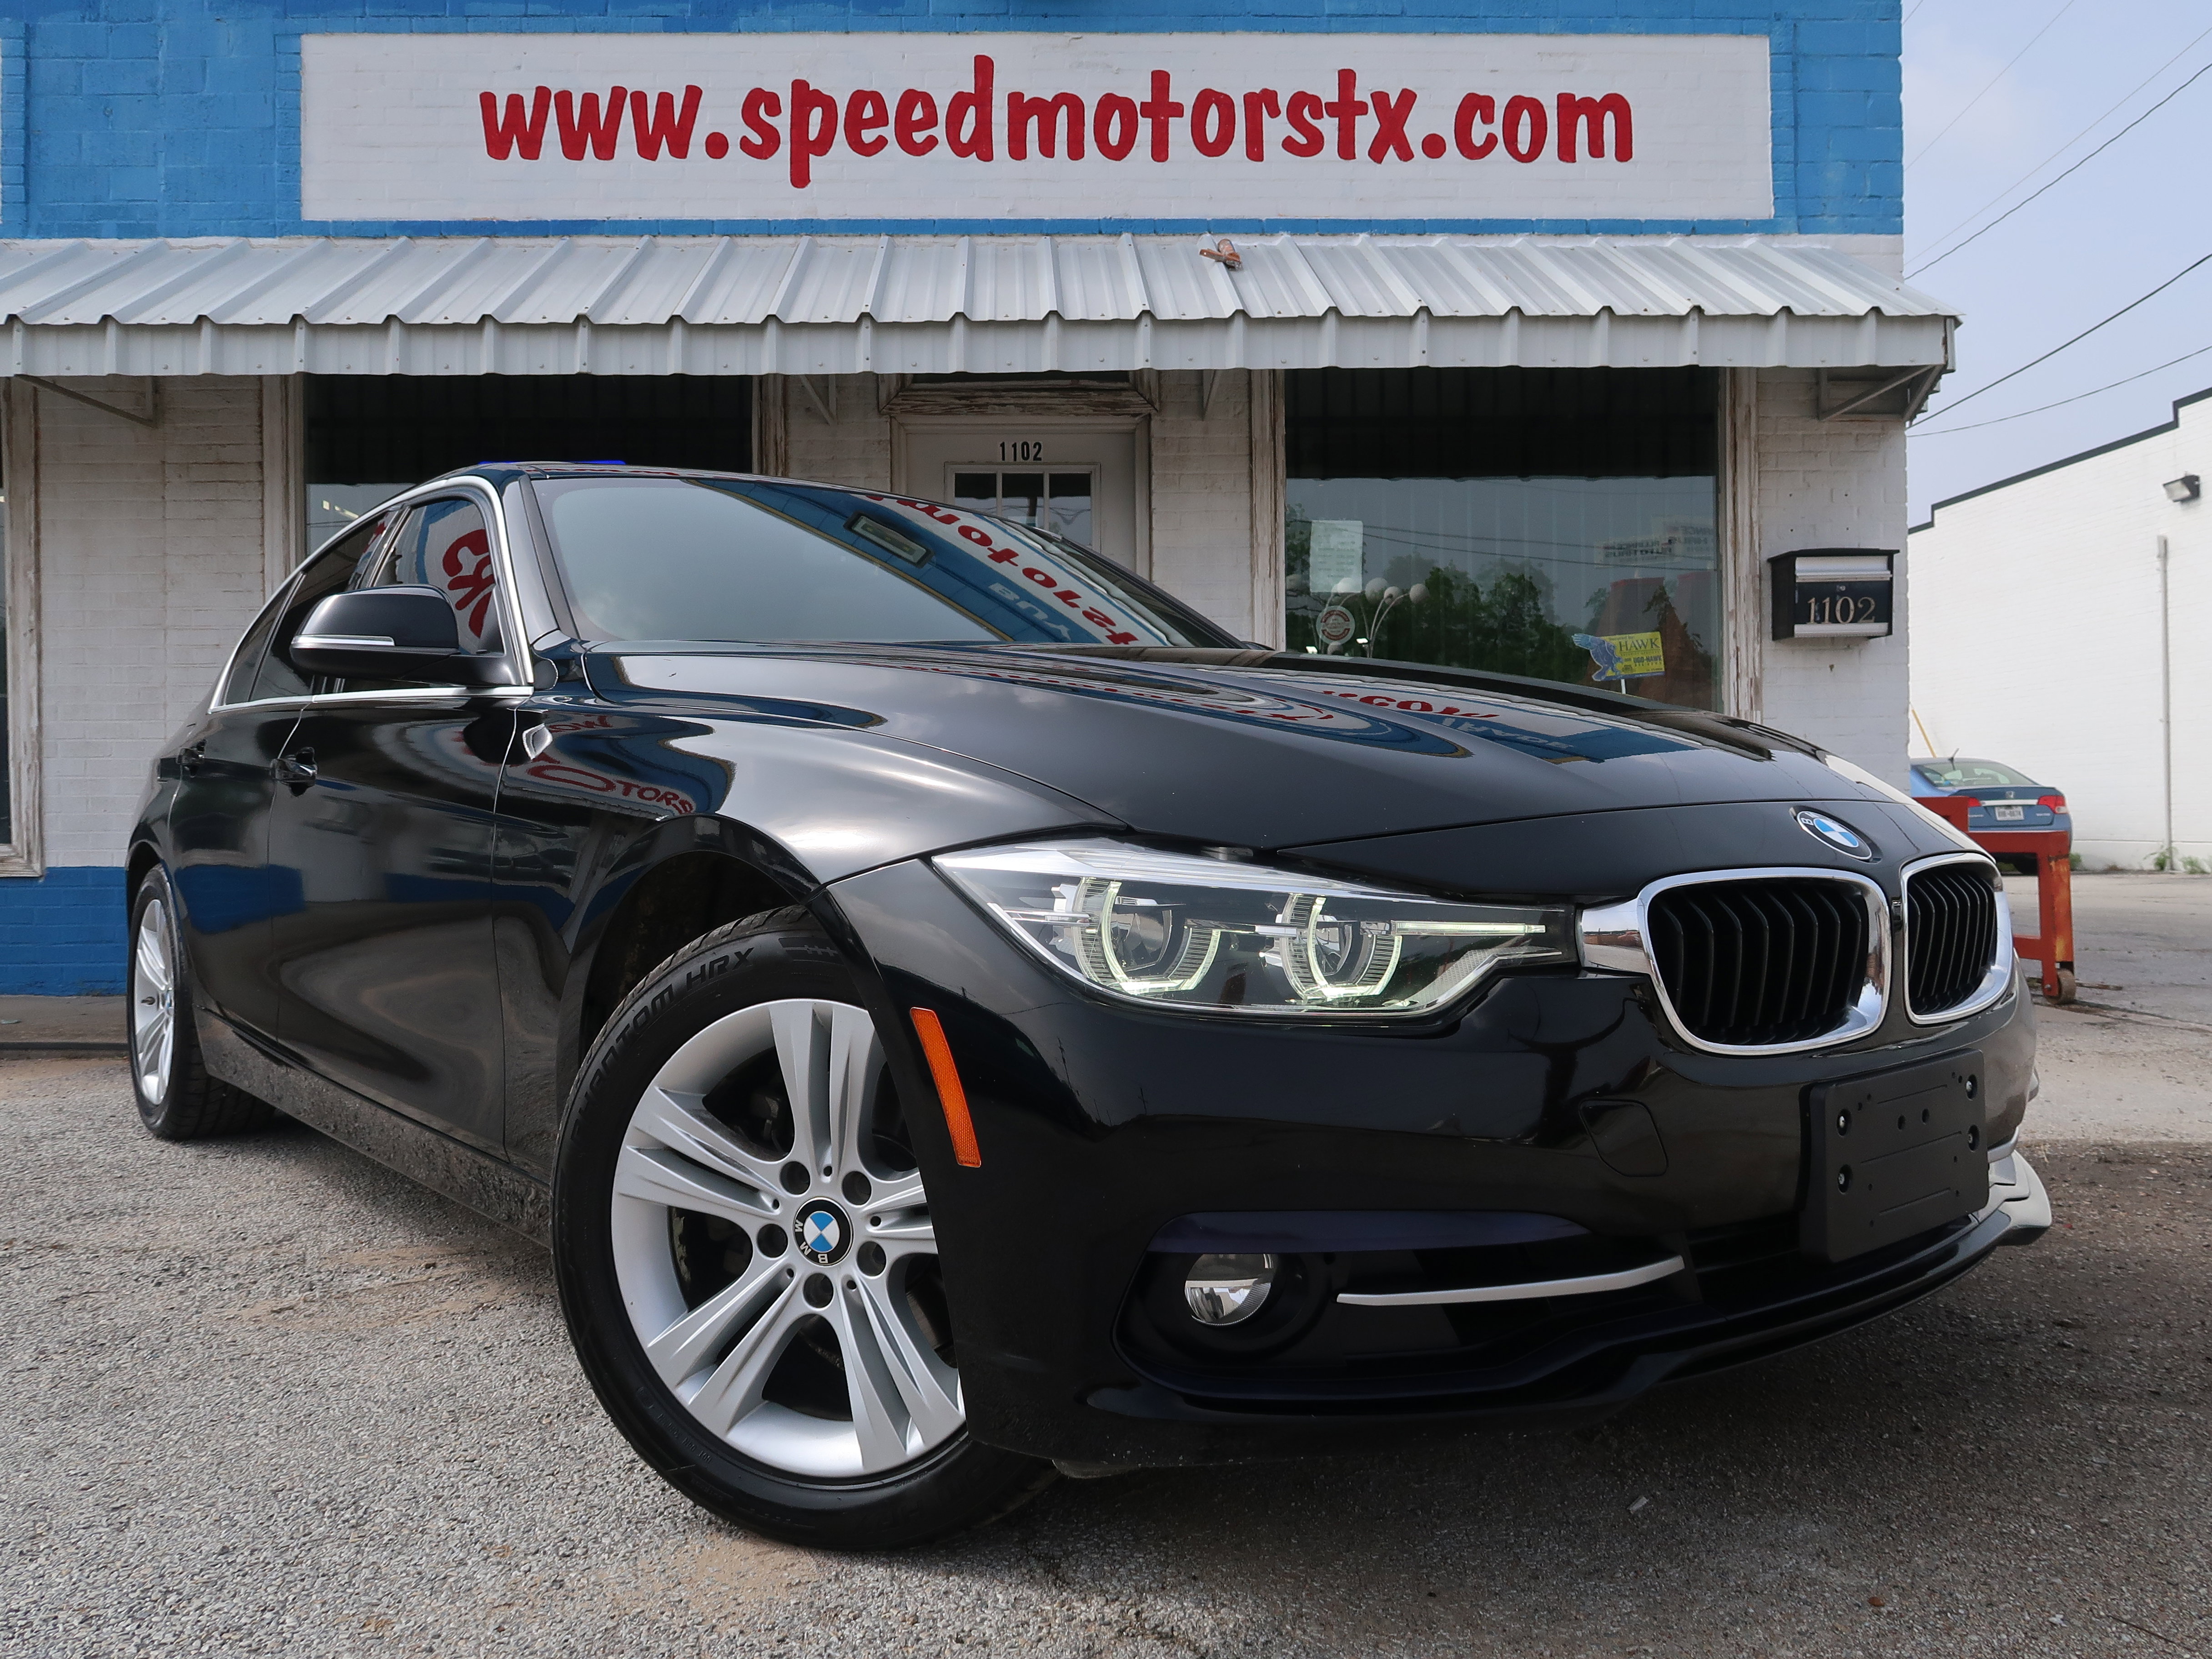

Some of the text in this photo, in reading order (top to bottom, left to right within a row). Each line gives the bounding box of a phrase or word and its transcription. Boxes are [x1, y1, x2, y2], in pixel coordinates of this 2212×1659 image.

[480, 55, 1633, 189] www.speedmotorstx.com
[1000, 442, 1042, 462] 1102
[1806, 596, 1875, 624] 1102
[1619, 638, 1660, 651] HAWK
[571, 947, 755, 1140] PHANTOM HRX
[794, 1219, 829, 1264] BMW
